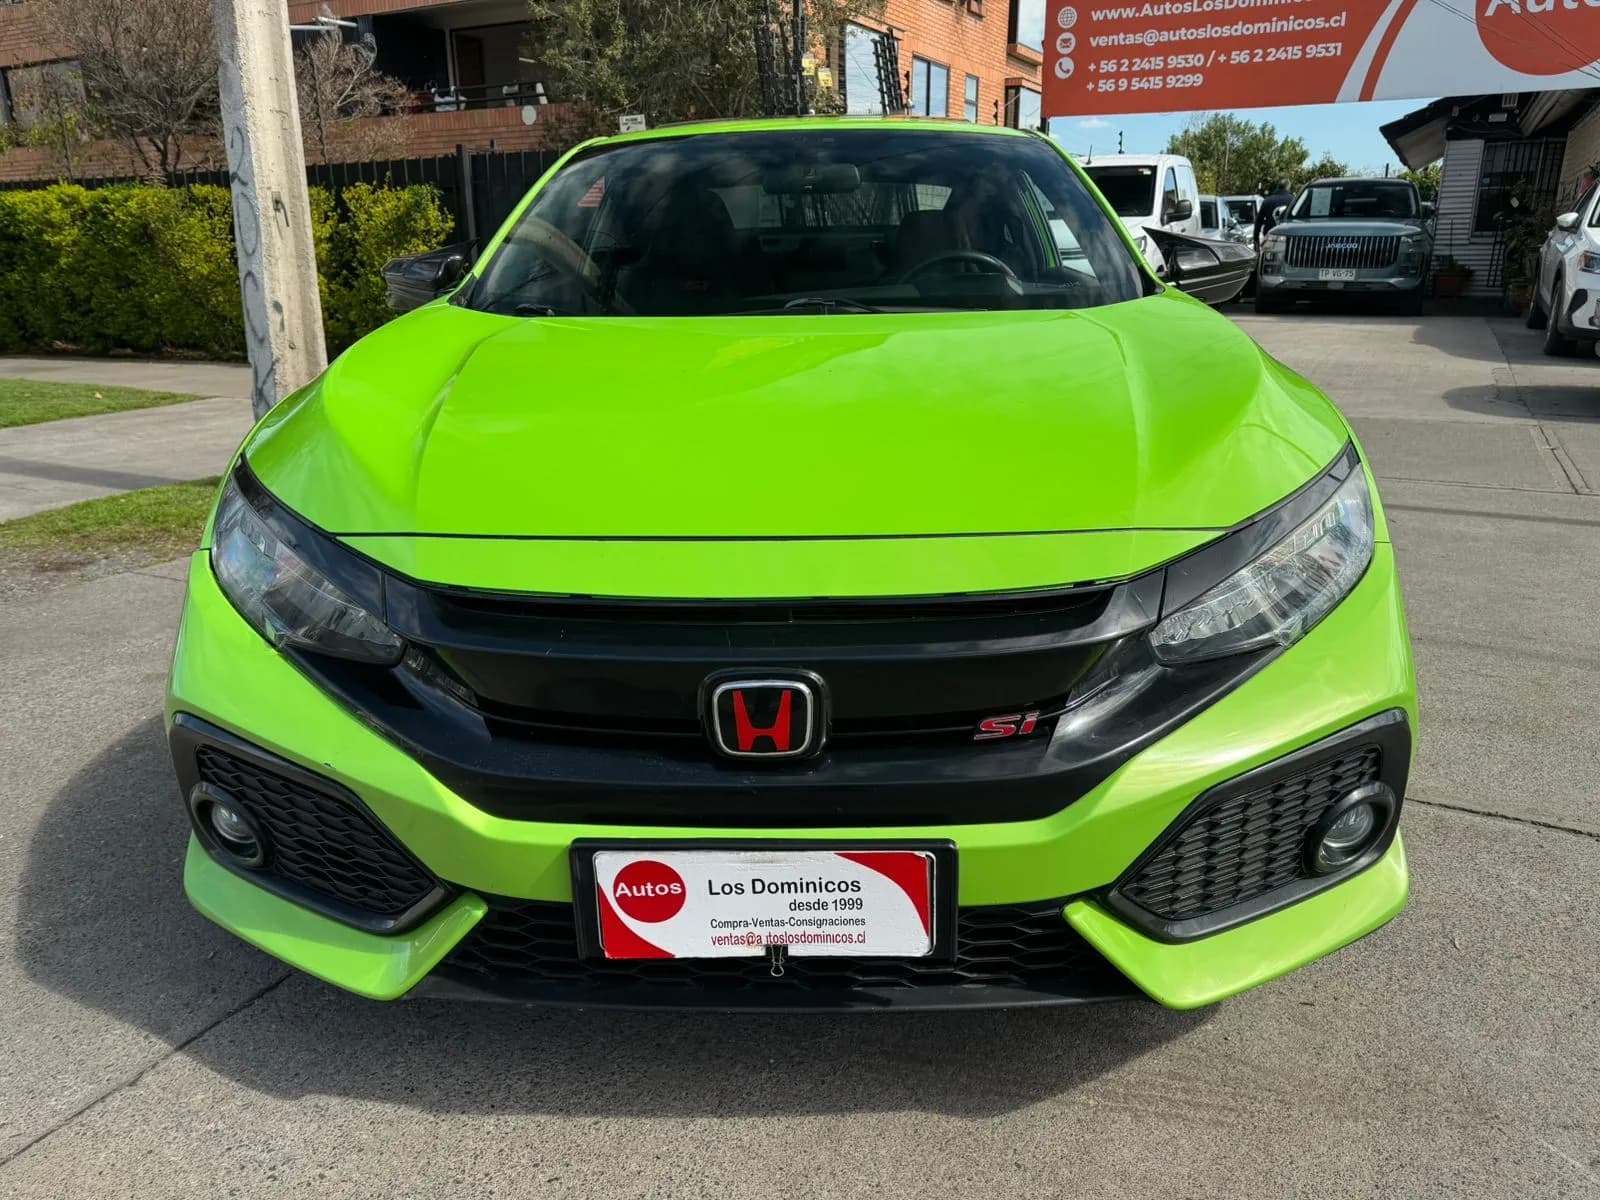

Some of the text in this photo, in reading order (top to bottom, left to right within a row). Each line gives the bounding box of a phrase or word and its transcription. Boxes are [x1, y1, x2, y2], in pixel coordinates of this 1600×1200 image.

[1089, 12, 1347, 47] ventas@autoslosdominicos.cl
[1099, 59, 1117, 73] 56
[1119, 58, 1129, 72] 2
[1131, 56, 1164, 71] 2415
[1167, 53, 1205, 69] 9530
[1230, 49, 1251, 64] 56
[1253, 48, 1264, 62] 2
[1265, 45, 1303, 62] 2415
[1305, 42, 1343, 59] 9531
[1097, 79, 1116, 93] 56
[1118, 78, 1129, 91] 9
[1130, 75, 1164, 90] 5415
[1166, 73, 1204, 89] 9299
[973, 712, 1040, 741] Si
[614, 881, 683, 898] Autos
[708, 876, 862, 896] Los Dominicos
[788, 897, 863, 912] desde 1999
[710, 915, 866, 930] Compra-Ventas-Consignaciones
